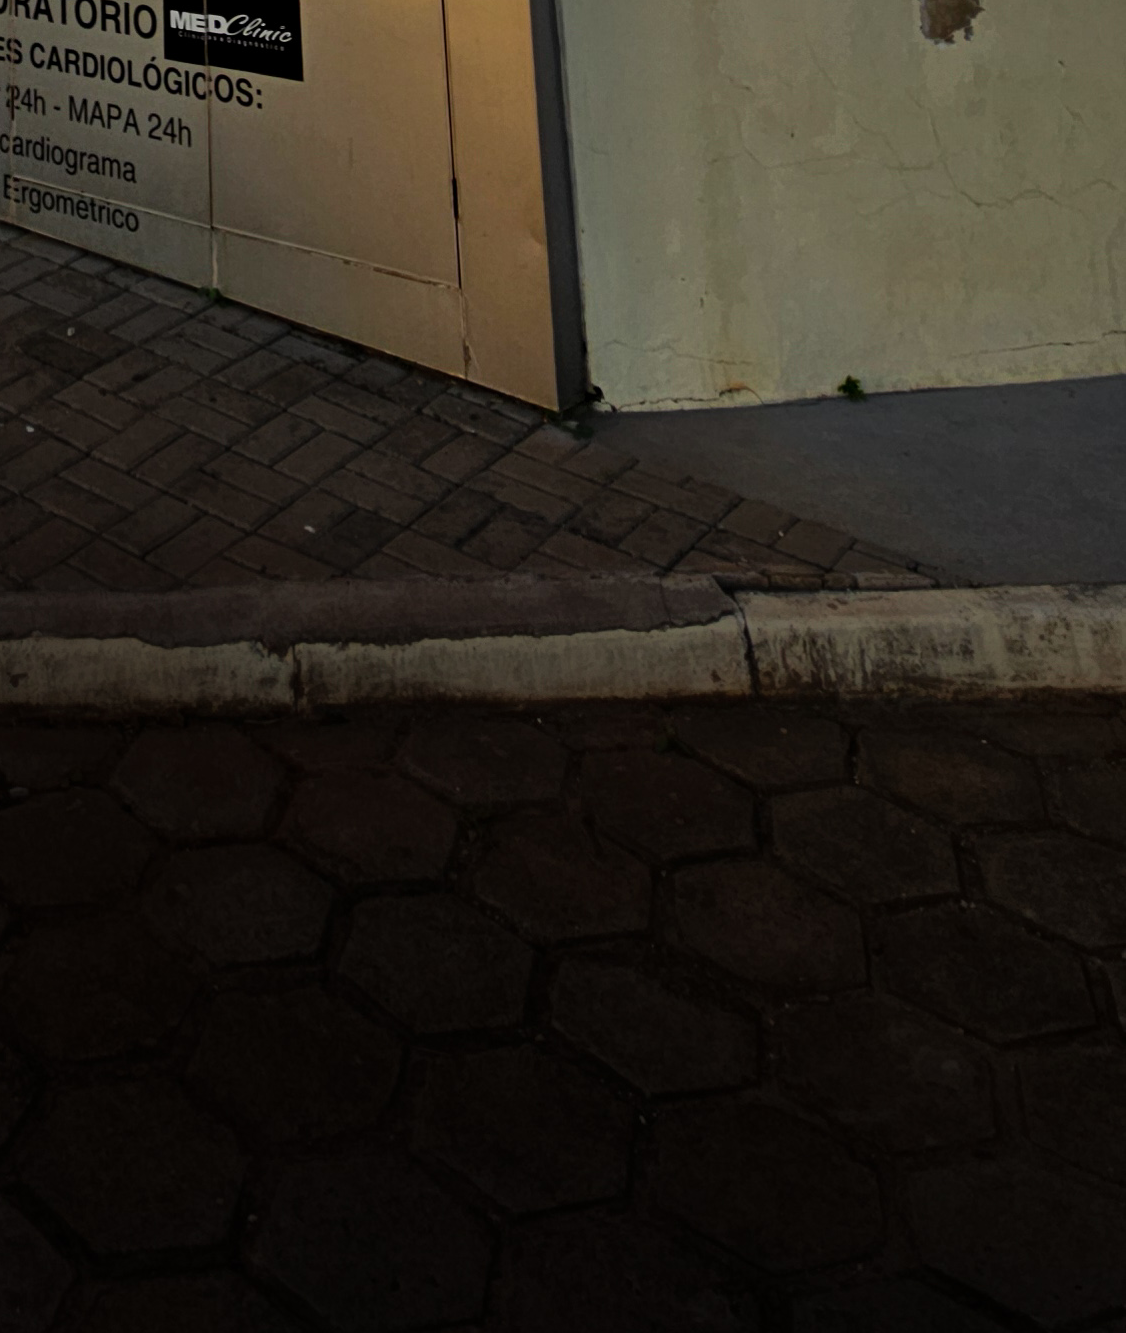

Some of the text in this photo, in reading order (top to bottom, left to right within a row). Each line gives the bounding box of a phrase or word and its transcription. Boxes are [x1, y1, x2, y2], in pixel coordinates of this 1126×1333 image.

[30, 42, 263, 109] CARDIOLÓGICOS:
[69, 95, 140, 136] MAPA
[148, 113, 192, 147] 24h
